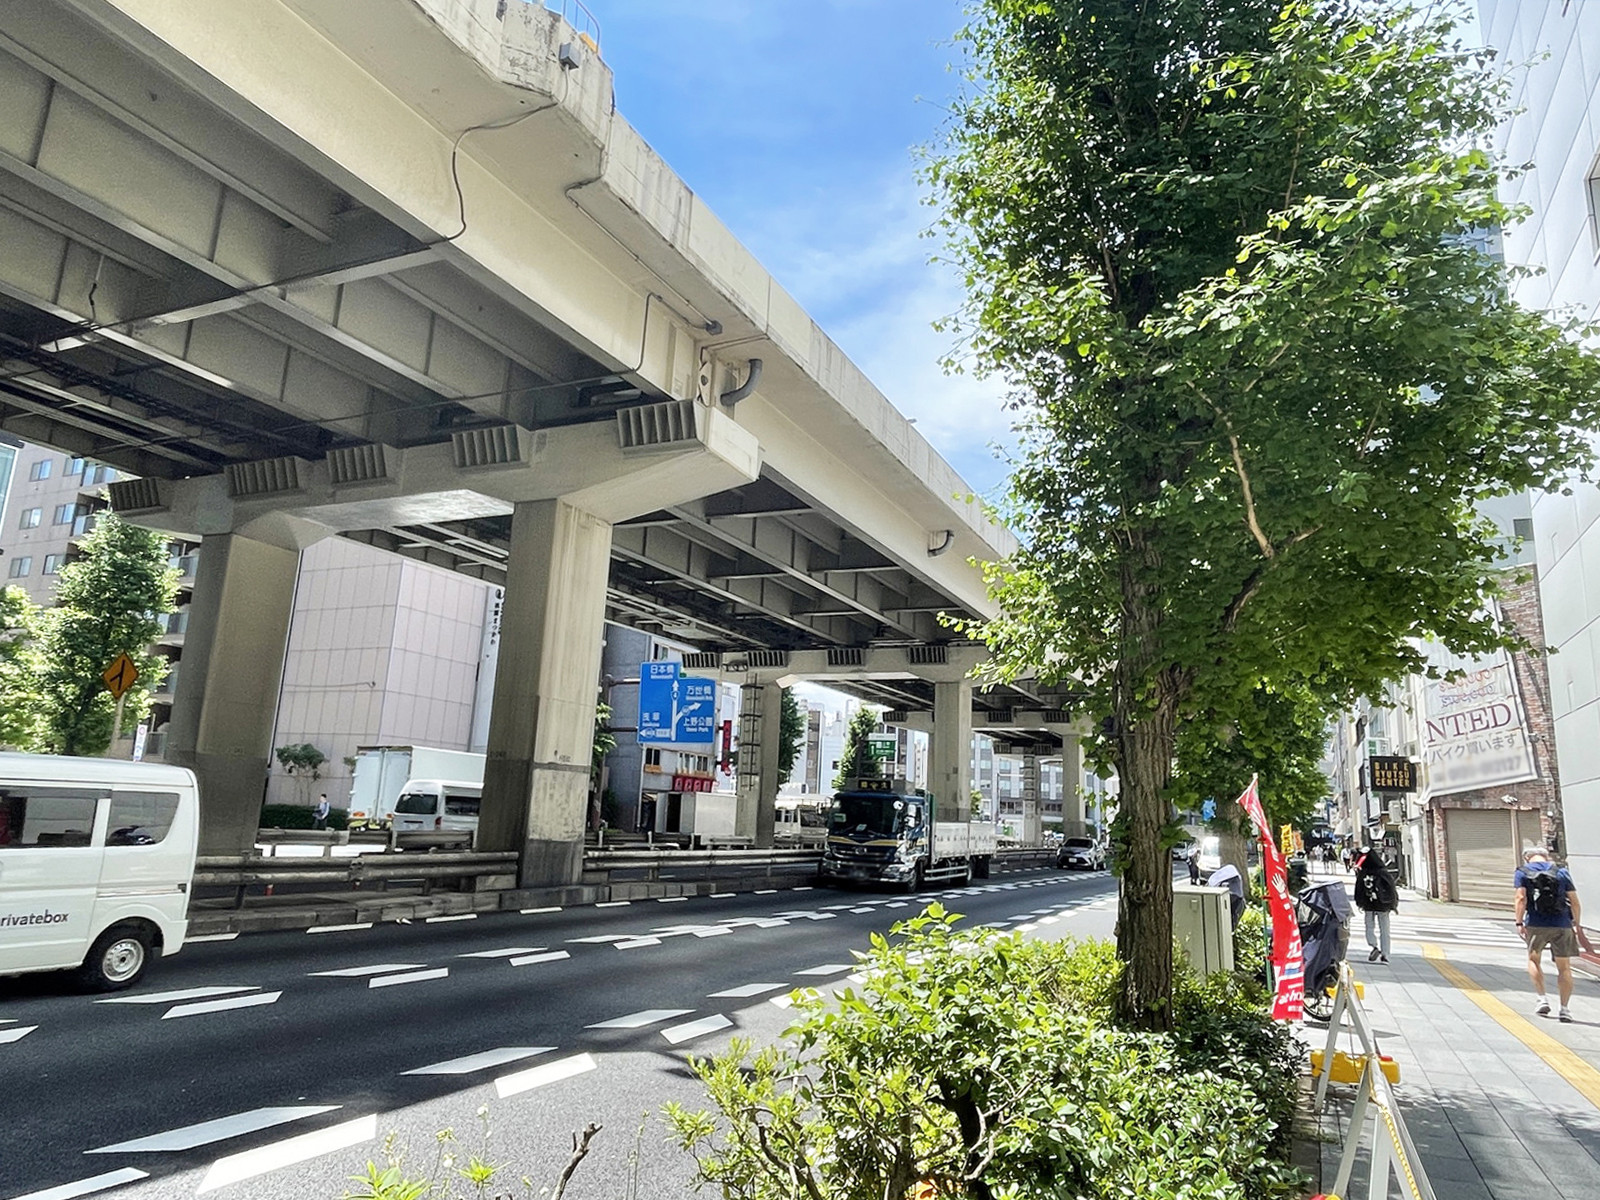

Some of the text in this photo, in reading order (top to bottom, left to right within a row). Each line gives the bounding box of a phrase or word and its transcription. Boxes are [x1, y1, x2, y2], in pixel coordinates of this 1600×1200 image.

[1425, 703, 1512, 743] NTED
[1432, 733, 1518, 761] バイク買います
[1374, 762, 1409, 770] BIKE
[1375, 770, 1410, 778] RYUTSU
[1375, 778, 1410, 787] CENTER
